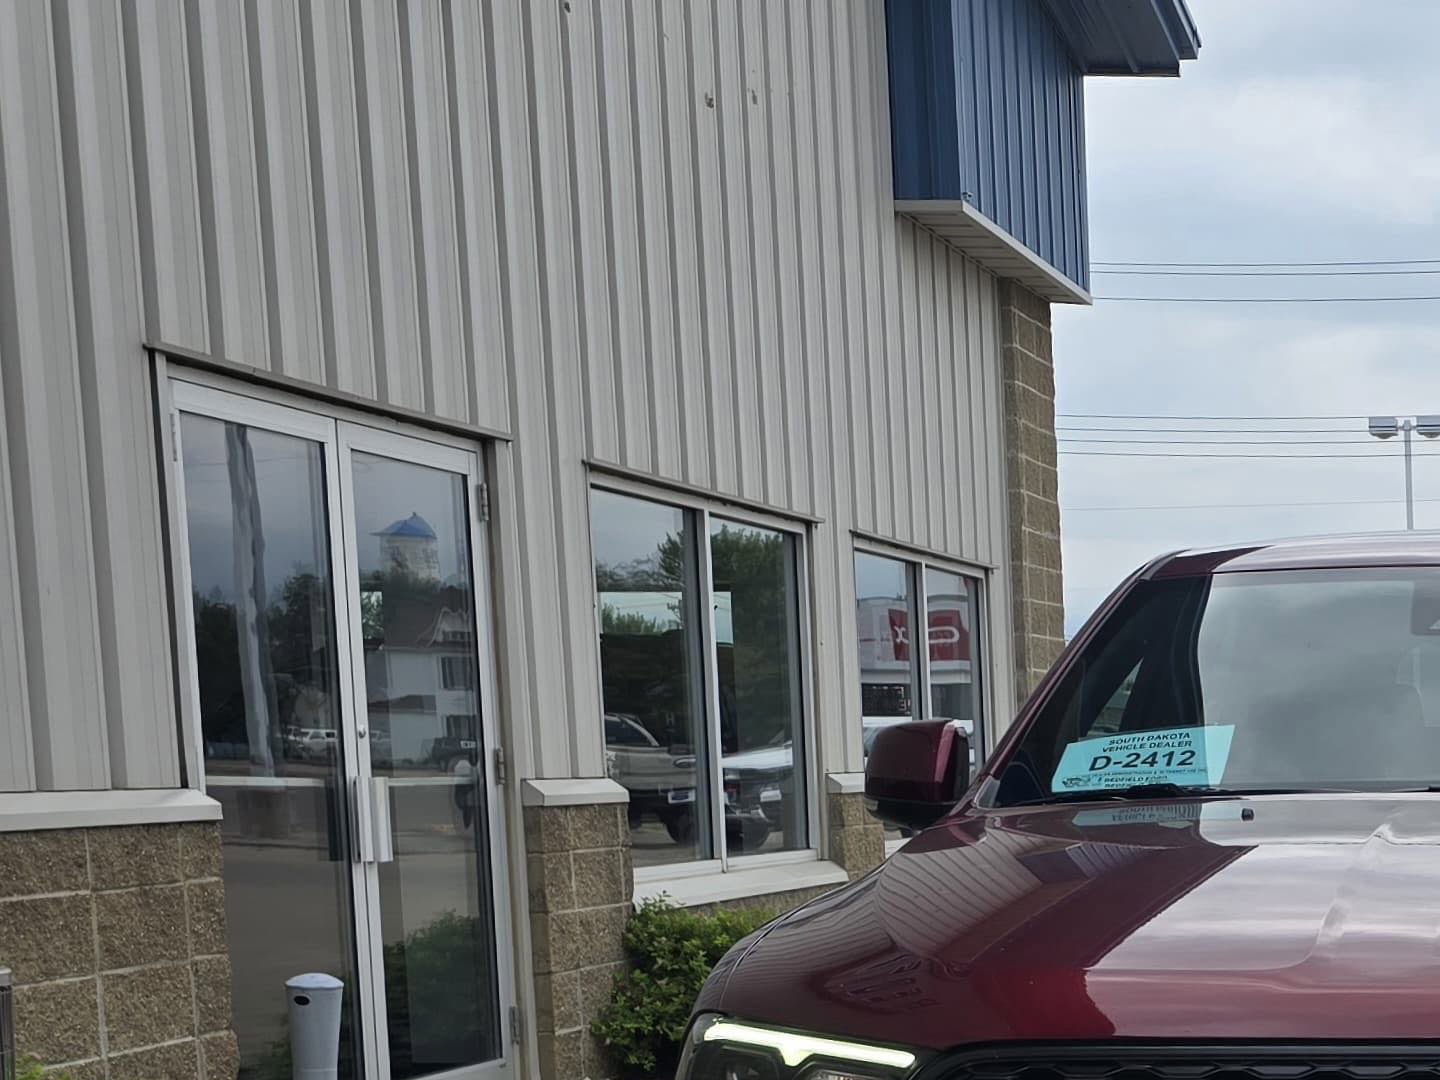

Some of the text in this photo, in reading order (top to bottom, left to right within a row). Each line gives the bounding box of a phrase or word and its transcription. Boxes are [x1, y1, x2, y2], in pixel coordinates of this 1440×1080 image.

[1103, 740, 1193, 752] VEHICLE DEALER
[1109, 732, 1191, 746] SOUTH DAKOTA
[1089, 750, 1196, 771] D-2412
